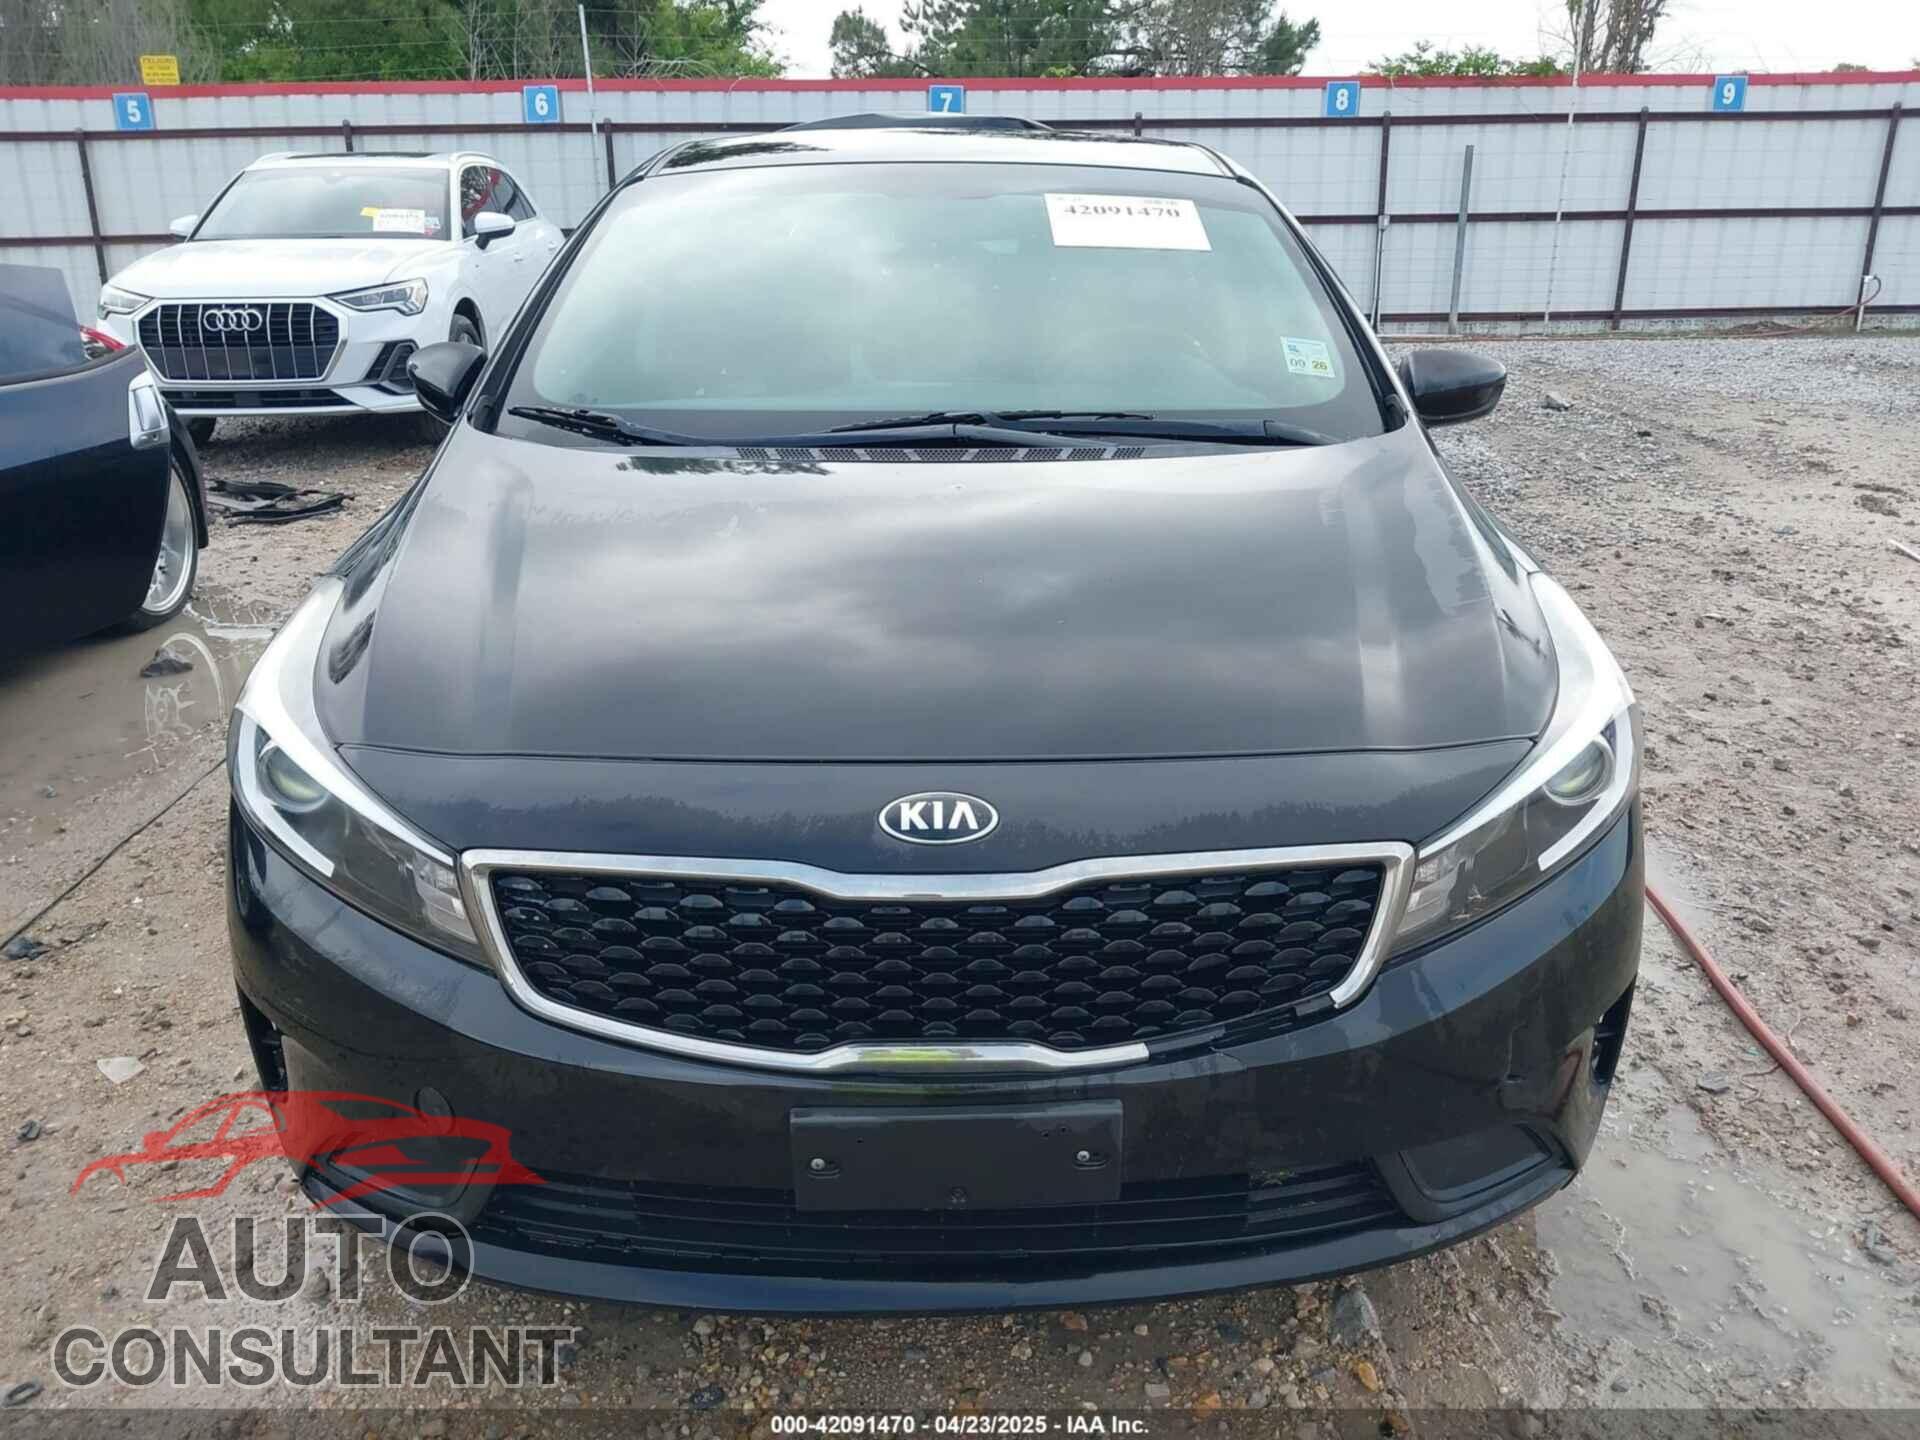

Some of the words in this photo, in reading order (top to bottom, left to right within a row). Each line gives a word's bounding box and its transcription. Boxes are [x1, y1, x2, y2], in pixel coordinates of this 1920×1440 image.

[535, 93, 549, 116] 6
[940, 92, 953, 113] 7
[1336, 88, 1349, 111] 8
[1722, 83, 1736, 105] 9
[127, 100, 141, 123] 5
[1064, 204, 1181, 218] 42091470
[900, 800, 979, 831] KIA
